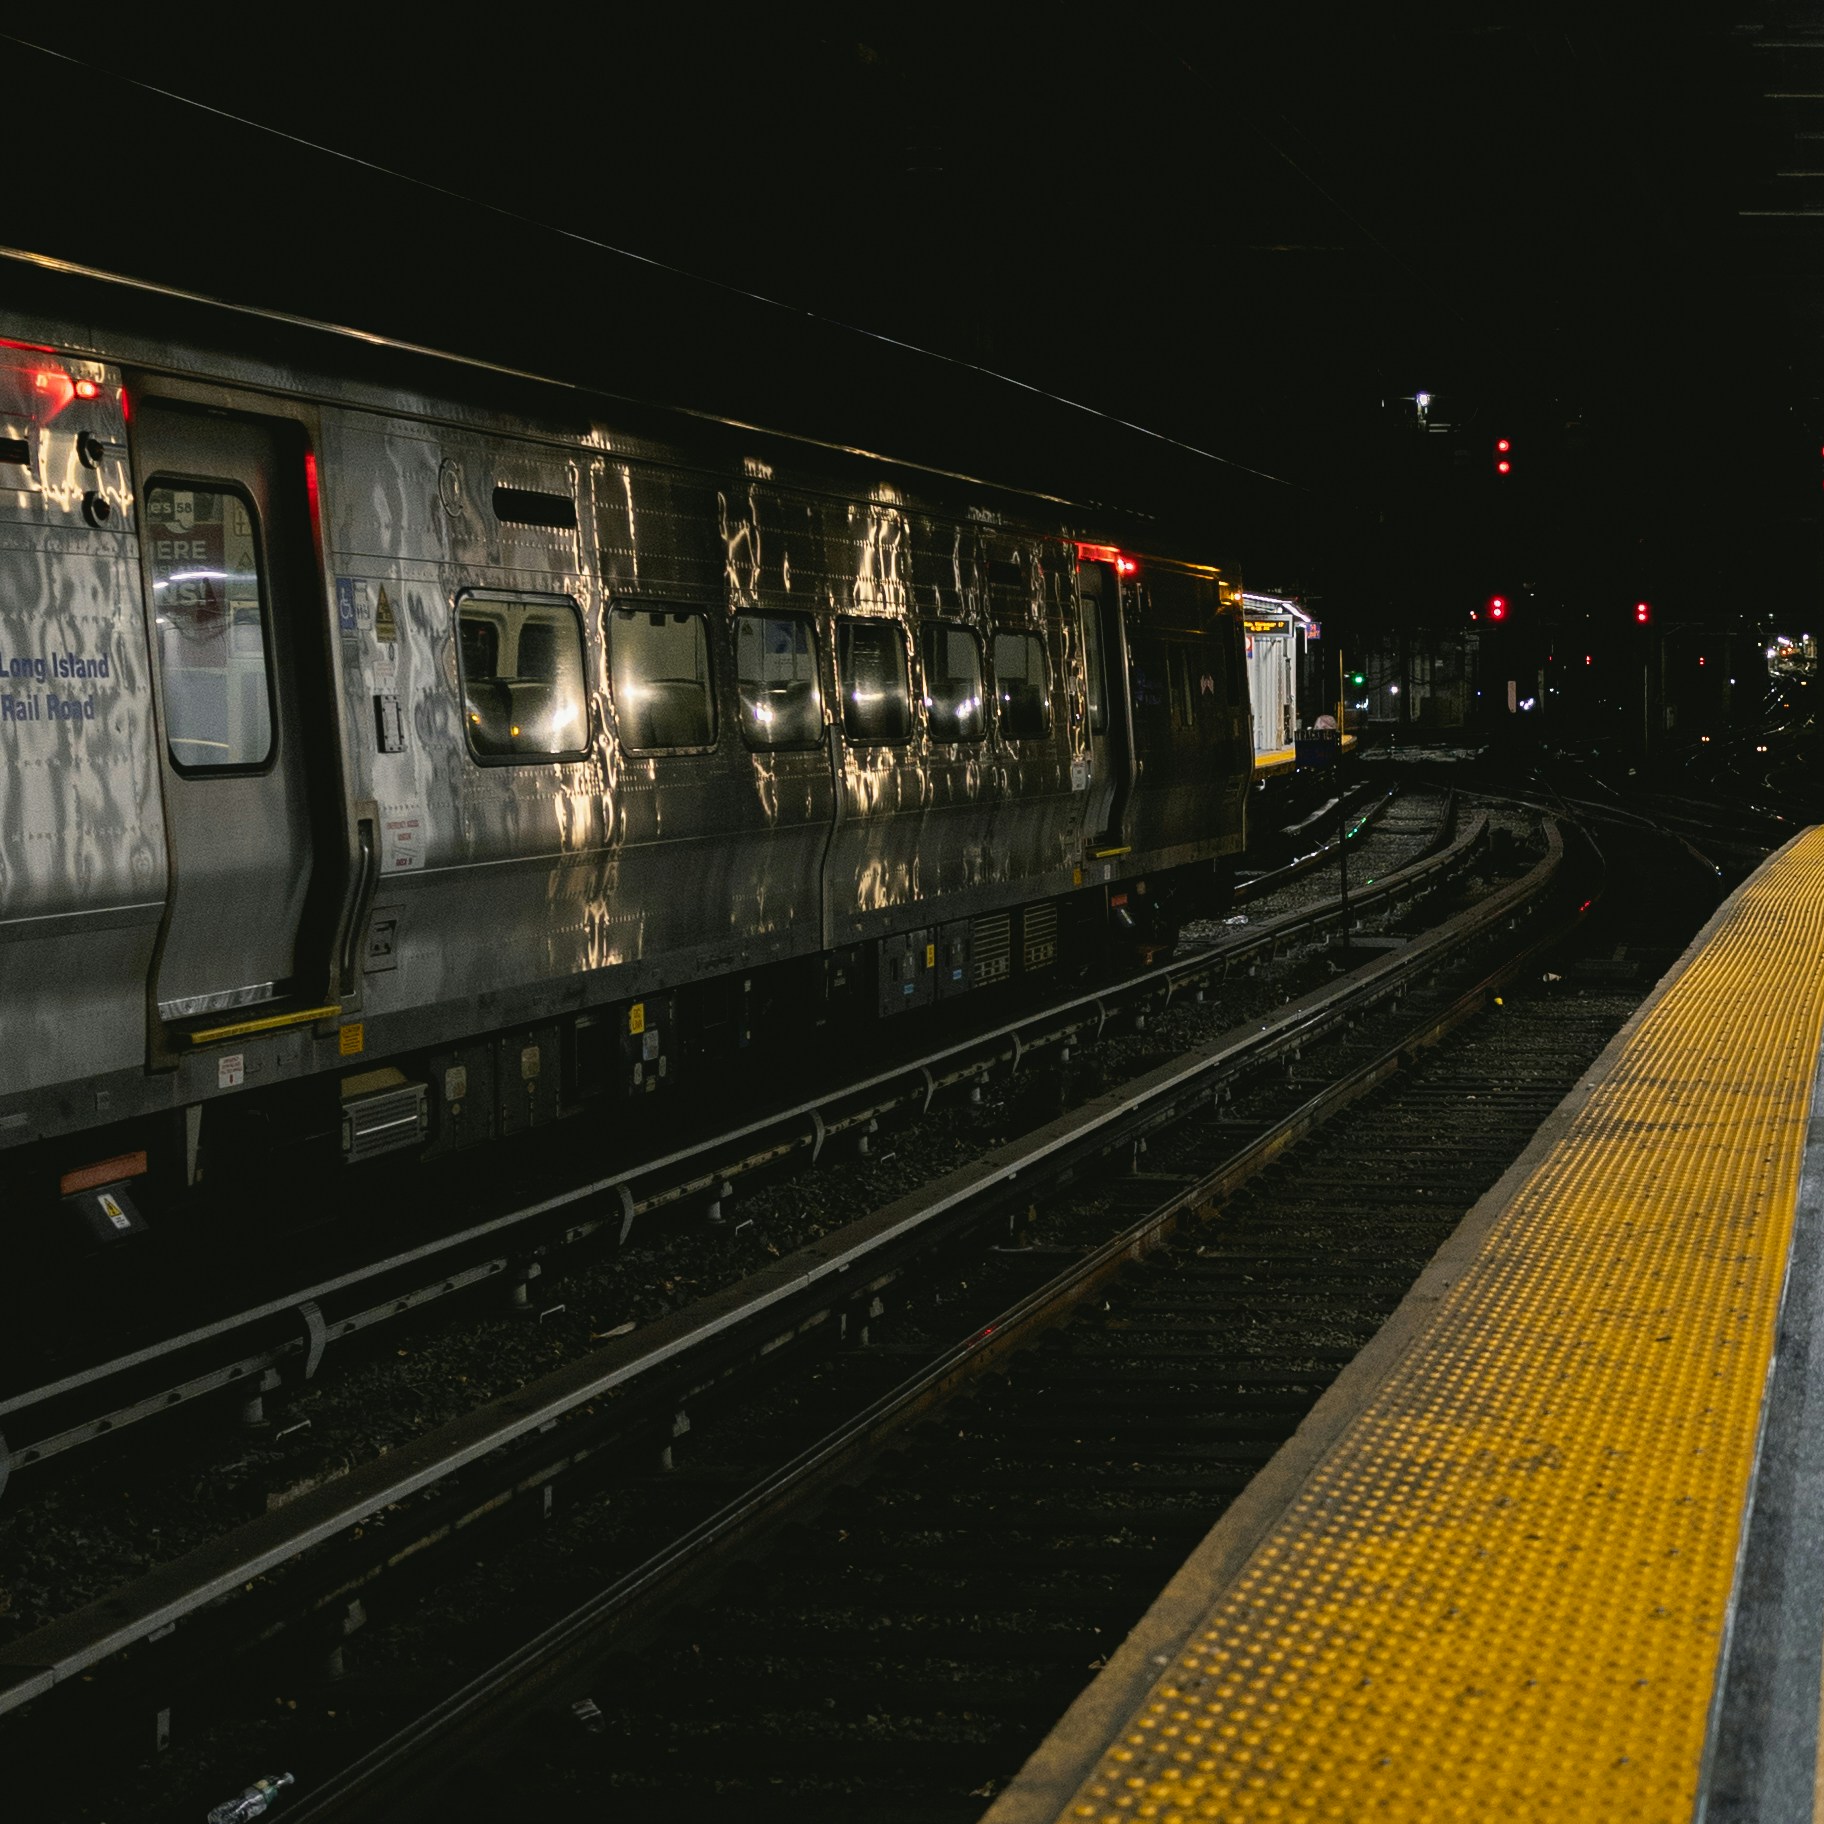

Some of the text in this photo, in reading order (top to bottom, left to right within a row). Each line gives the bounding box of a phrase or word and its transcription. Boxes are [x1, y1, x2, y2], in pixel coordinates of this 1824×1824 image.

[153, 540, 208, 560] ERE
[0, 652, 109, 683] Long Island
[1, 694, 95, 721] Rail Road
